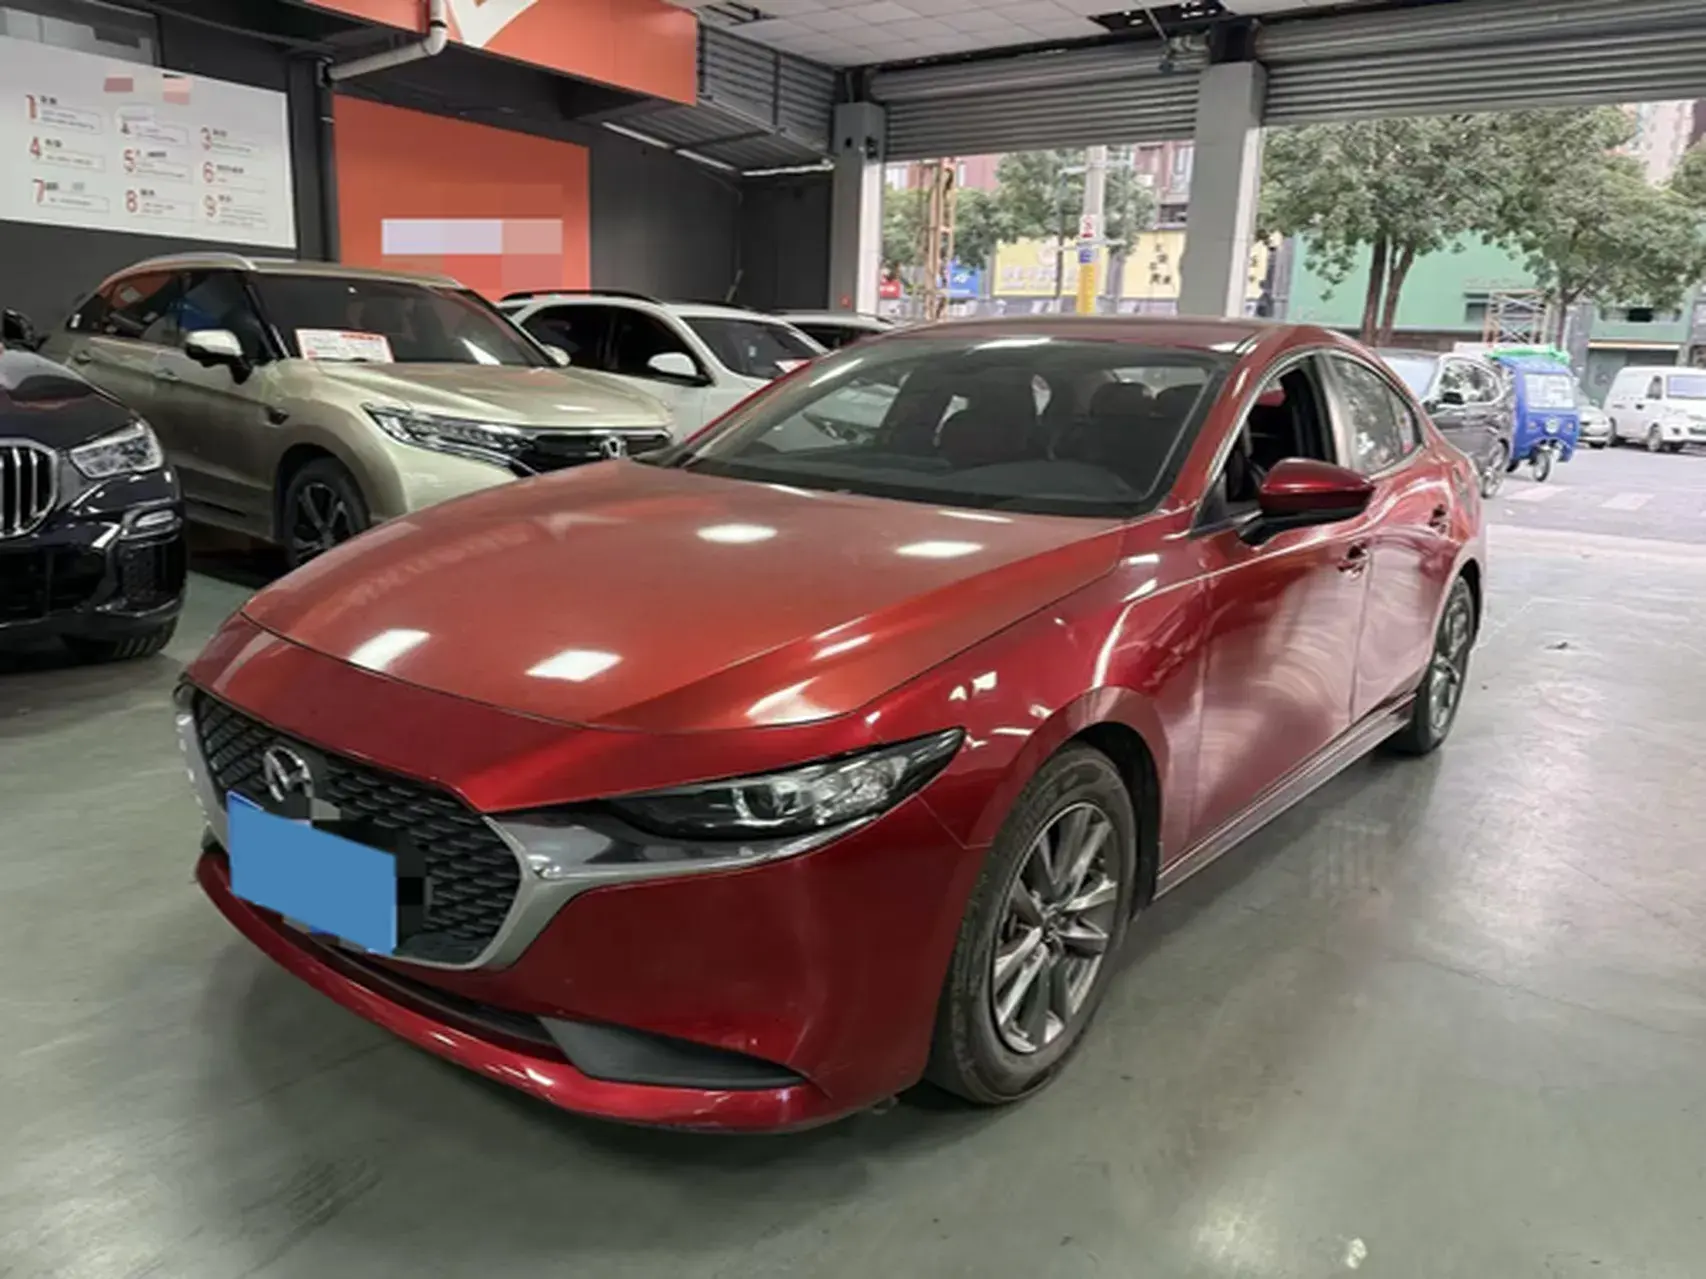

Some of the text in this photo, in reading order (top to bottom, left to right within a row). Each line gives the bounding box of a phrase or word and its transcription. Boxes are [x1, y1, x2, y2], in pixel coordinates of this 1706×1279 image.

[26, 94, 37, 119] 1
[30, 136, 41, 159] 4
[201, 127, 212, 150] 3
[123, 149, 135, 172] 5
[203, 161, 214, 183] 6
[33, 179, 44, 203] 7
[126, 189, 138, 213] 8
[205, 195, 216, 217] 9
